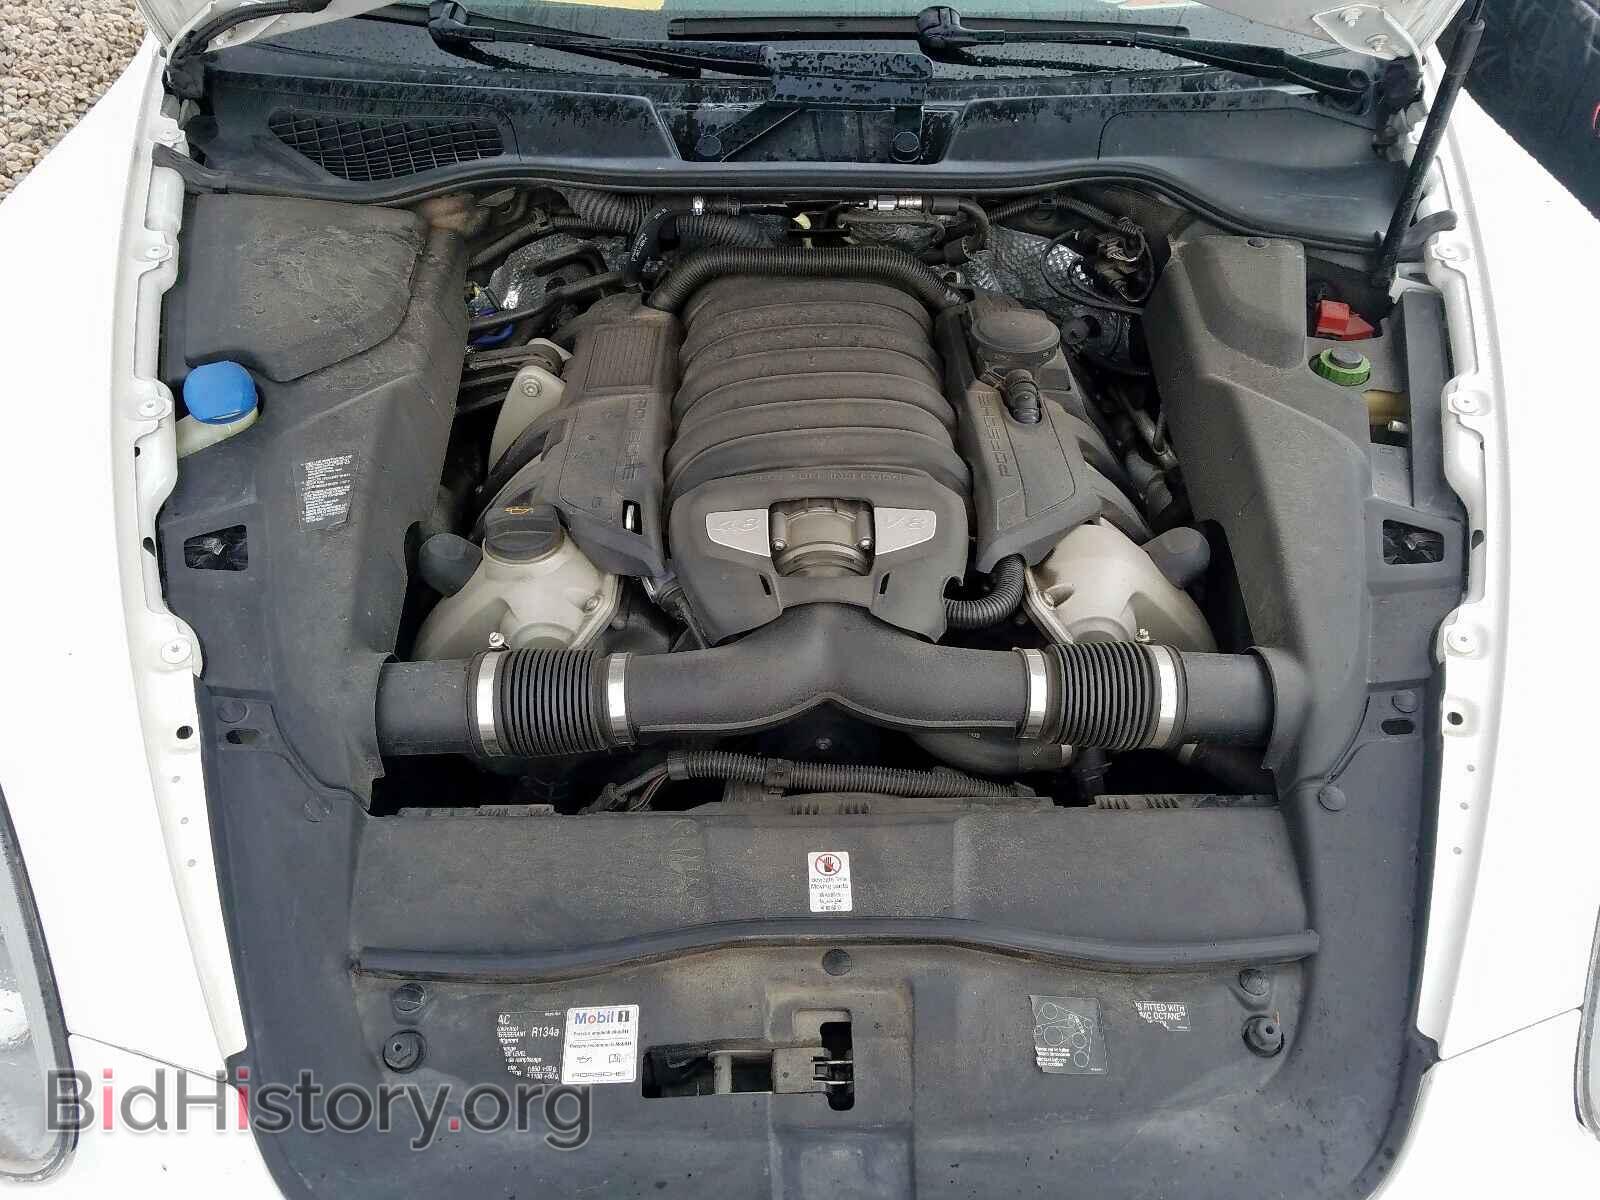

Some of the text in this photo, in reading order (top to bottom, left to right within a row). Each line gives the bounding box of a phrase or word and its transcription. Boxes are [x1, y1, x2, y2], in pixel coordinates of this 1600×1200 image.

[1143, 1002, 1167, 1012] FITTED
[1167, 1003, 1185, 1012] WITH
[497, 1014, 511, 1025] AC
[574, 1010, 615, 1024] Mobil
[530, 1026, 560, 1038] R134a
